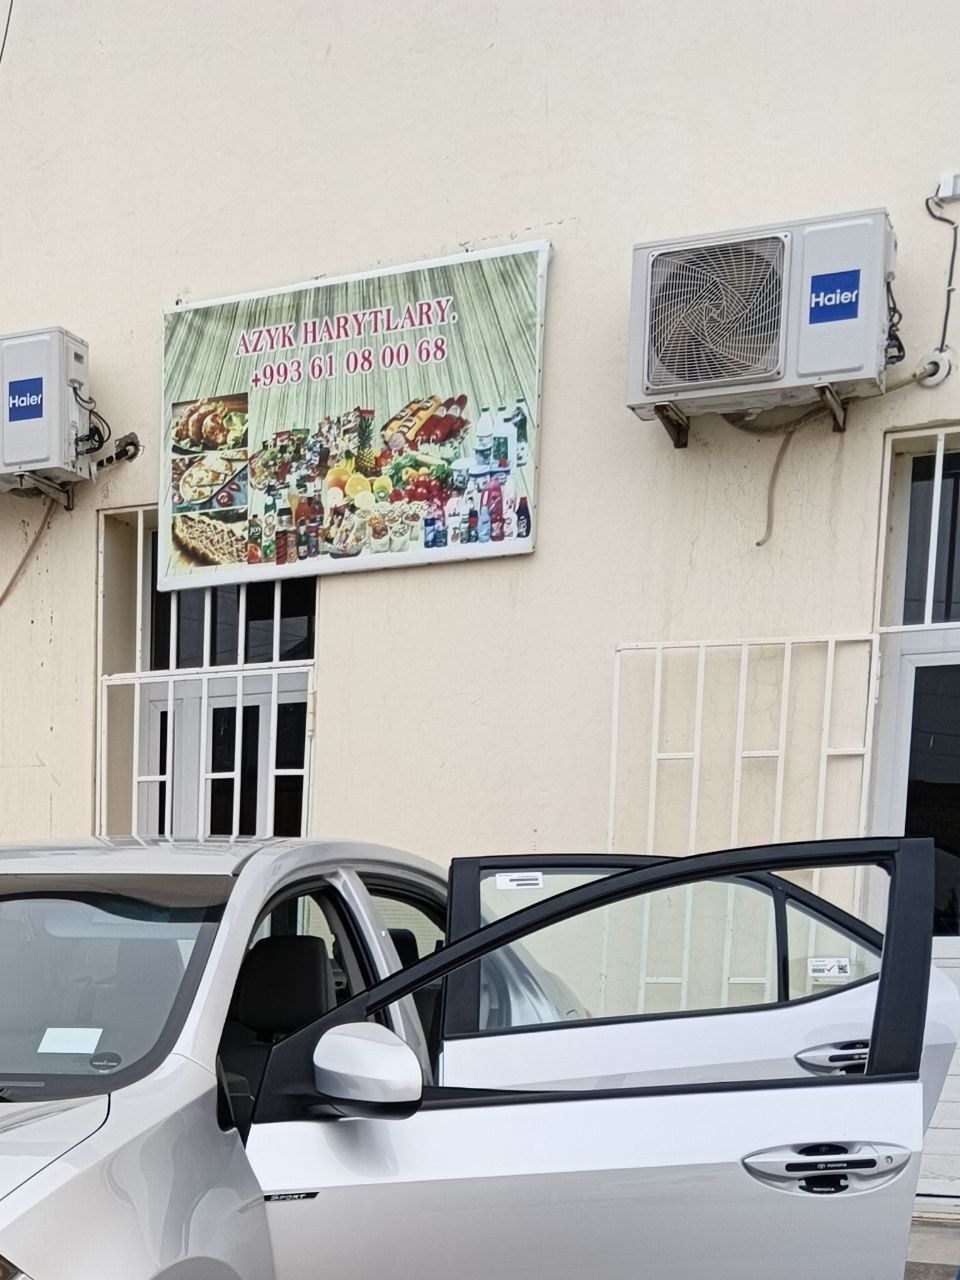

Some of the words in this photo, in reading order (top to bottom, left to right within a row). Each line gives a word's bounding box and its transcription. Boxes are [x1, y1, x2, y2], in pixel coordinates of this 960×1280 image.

[810, 289, 859, 308] Haier
[236, 324, 294, 356] AZYK
[302, 298, 458, 345] HARYTLARY.
[251, 359, 302, 389] +993
[310, 354, 334, 379] 61
[345, 348, 372, 375] 08
[381, 342, 409, 368] 00
[418, 336, 446, 363] 68
[8, 393, 43, 409] Haier
